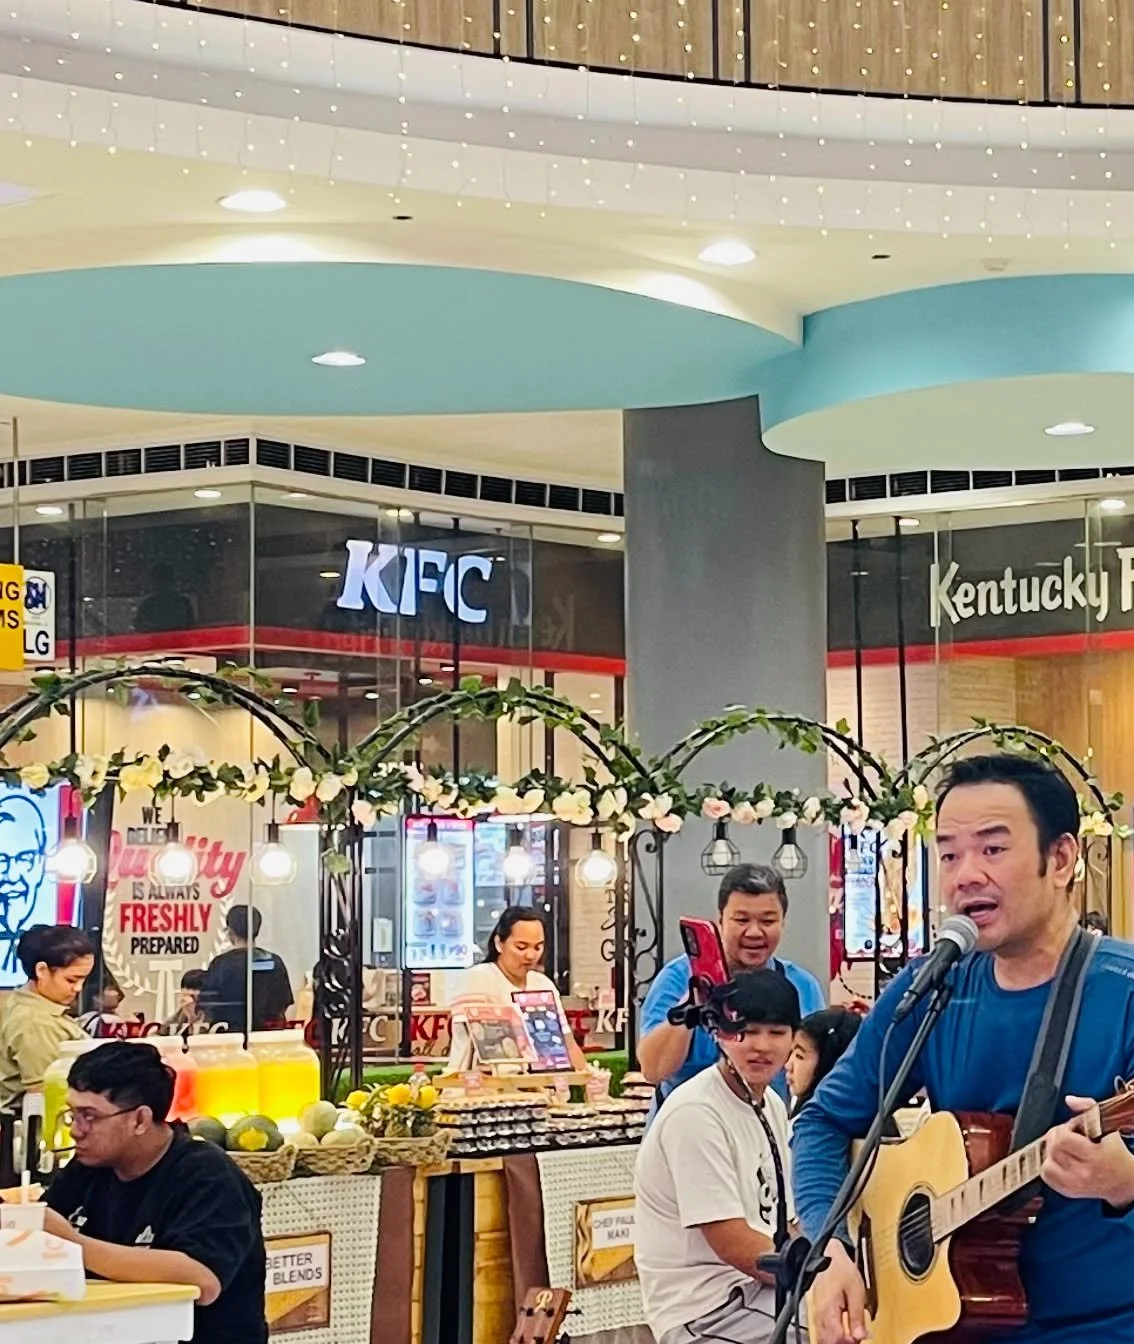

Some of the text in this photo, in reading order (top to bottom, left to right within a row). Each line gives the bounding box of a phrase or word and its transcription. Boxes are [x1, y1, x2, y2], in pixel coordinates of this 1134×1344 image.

[336, 539, 493, 624] KFC
[930, 555, 1109, 628] Kentucky
[141, 806, 162, 825] WE
[119, 903, 213, 934] FRESHLY
[130, 936, 200, 955] PREPARED
[265, 1252, 313, 1271] BETTER
[272, 1266, 323, 1286] BLENDS
